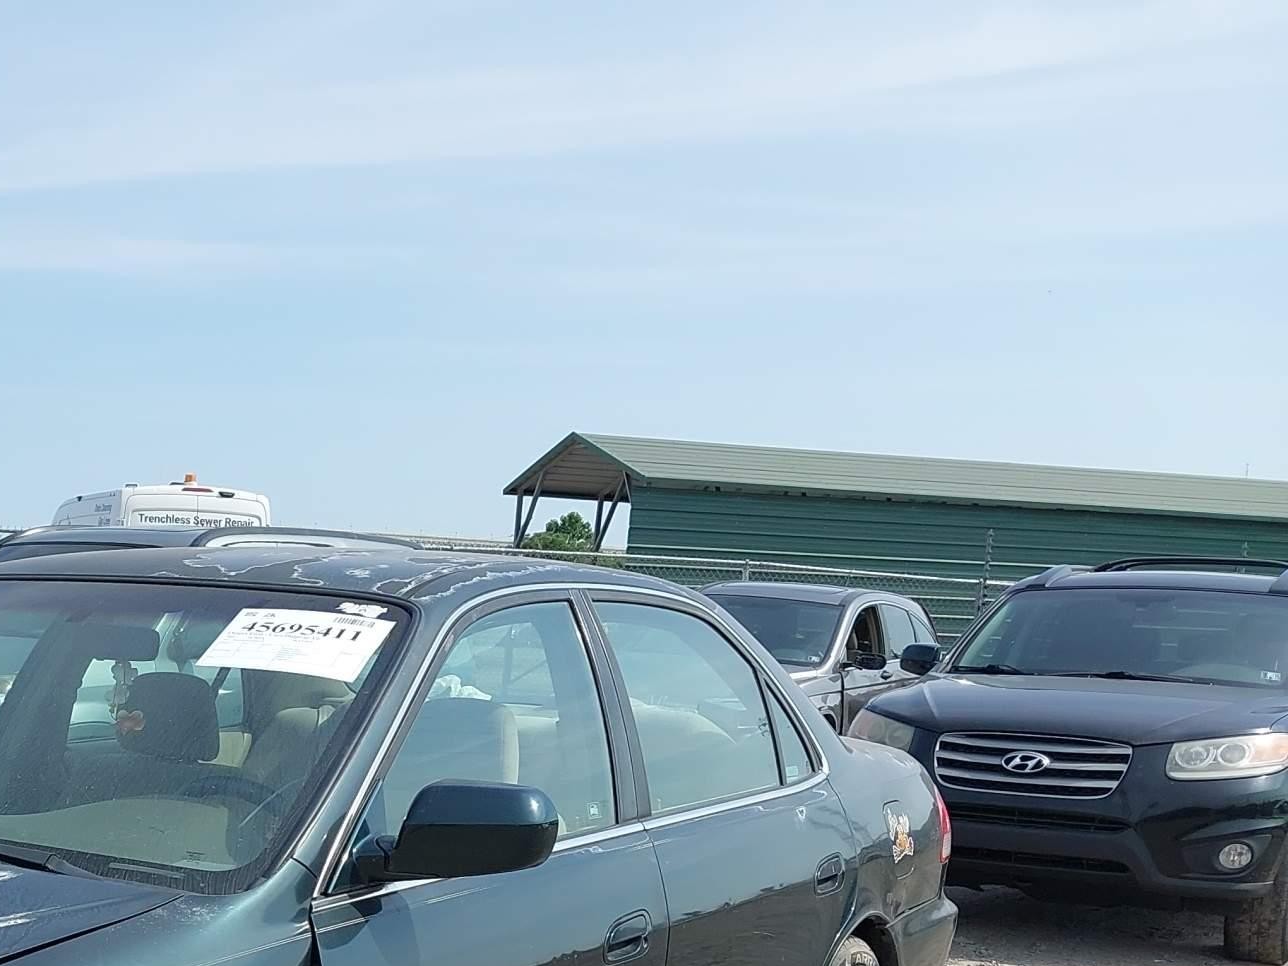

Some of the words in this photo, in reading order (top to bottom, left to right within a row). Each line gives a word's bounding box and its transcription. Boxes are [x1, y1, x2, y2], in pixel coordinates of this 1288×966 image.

[138, 513, 191, 525] Trenchless
[193, 515, 222, 527] Sewer
[241, 621, 362, 642] 45695411
